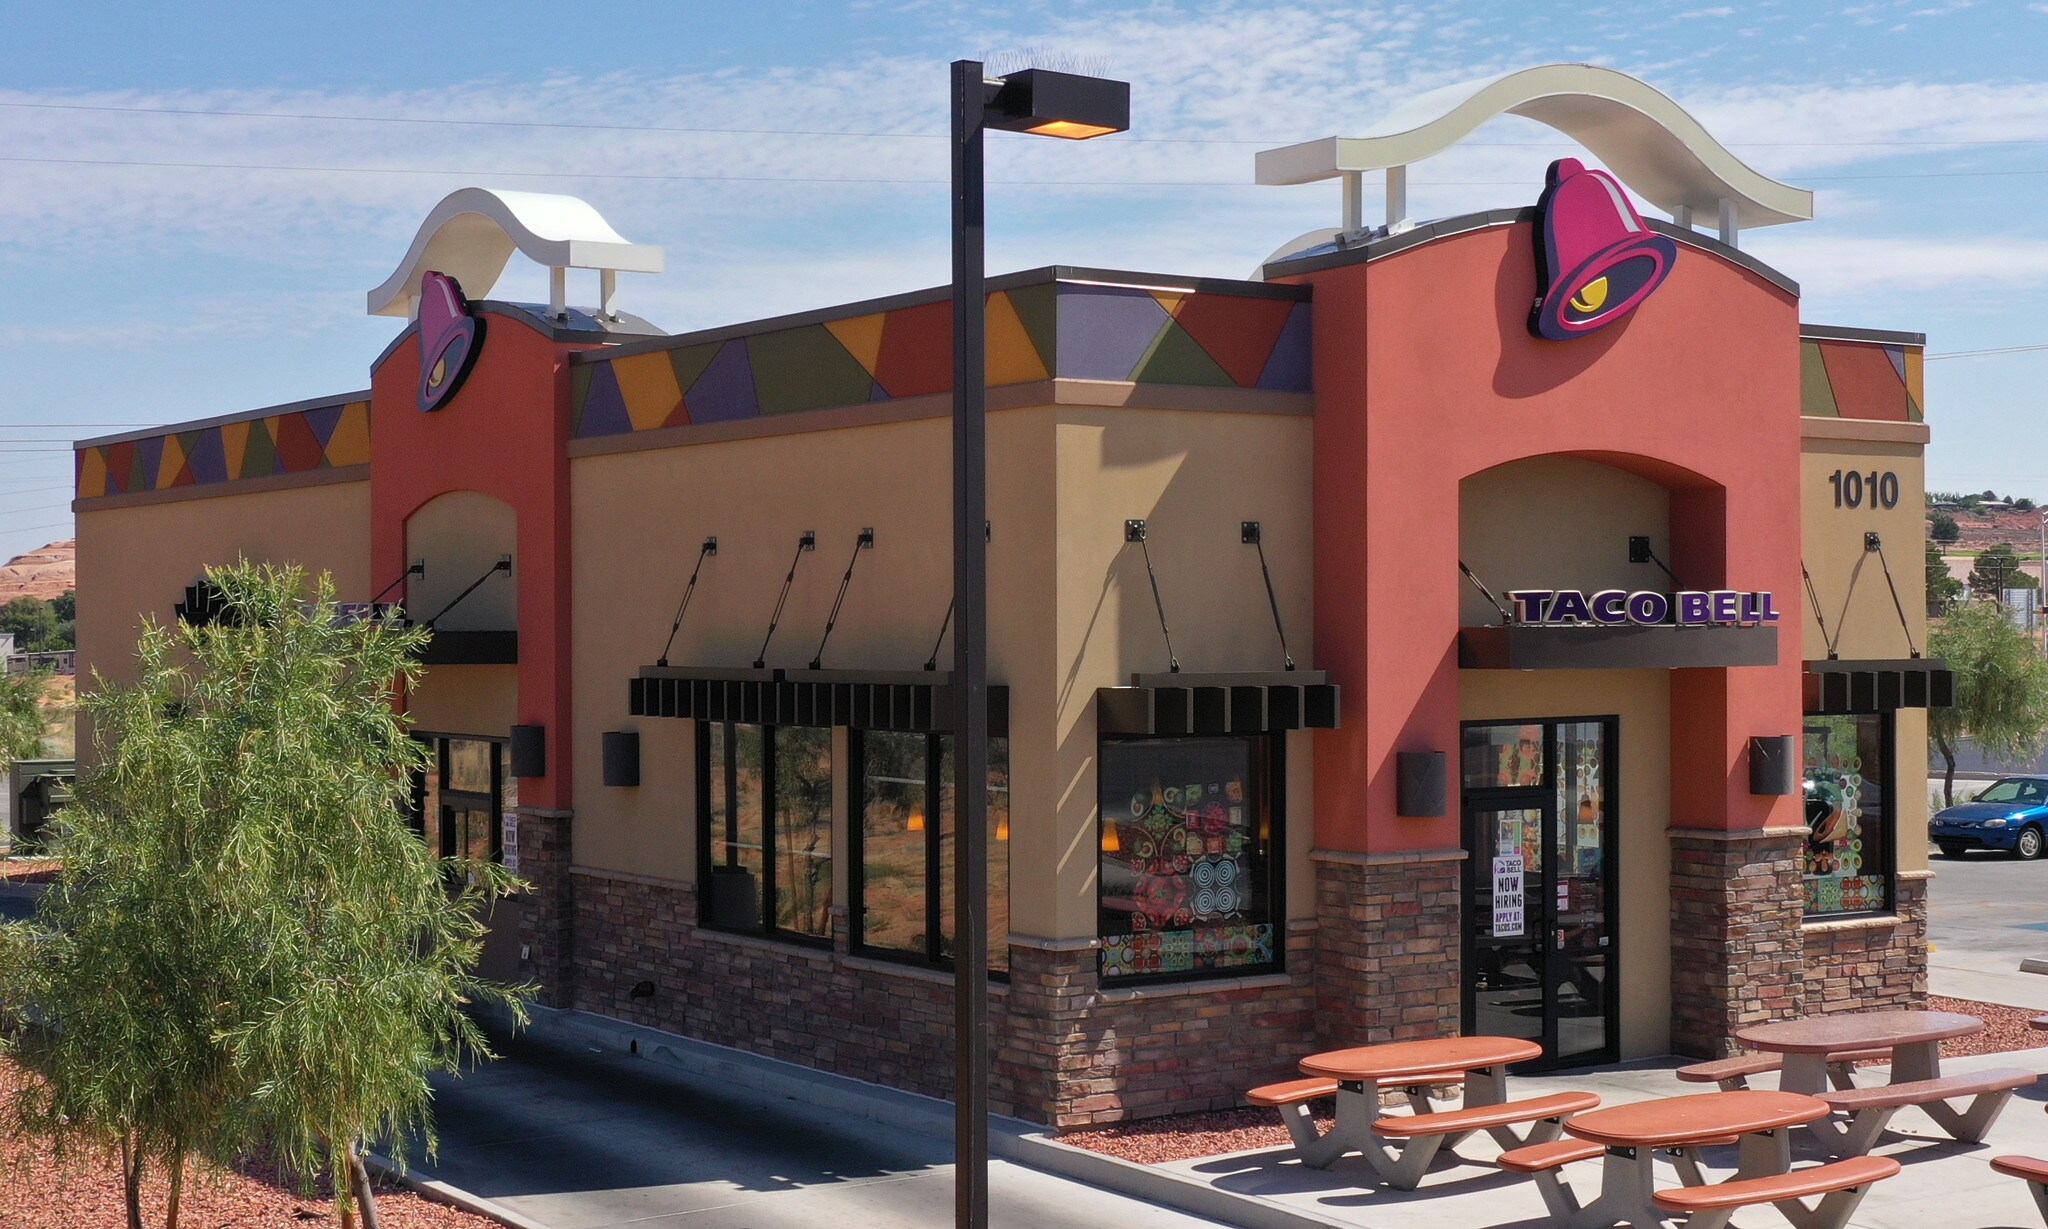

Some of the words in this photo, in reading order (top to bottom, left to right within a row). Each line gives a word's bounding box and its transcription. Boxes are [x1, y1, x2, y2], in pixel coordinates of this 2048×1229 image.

[1828, 469, 1899, 510] 1010
[1504, 590, 1667, 624] TACO
[1676, 590, 1780, 625] BELL
[1498, 876, 1519, 893] NOW
[1495, 894, 1522, 909] HIRING
[1495, 912, 1513, 923] APPLY
[1513, 912, 1522, 921] AT:
[1495, 922, 1522, 933] TACOS.COM
